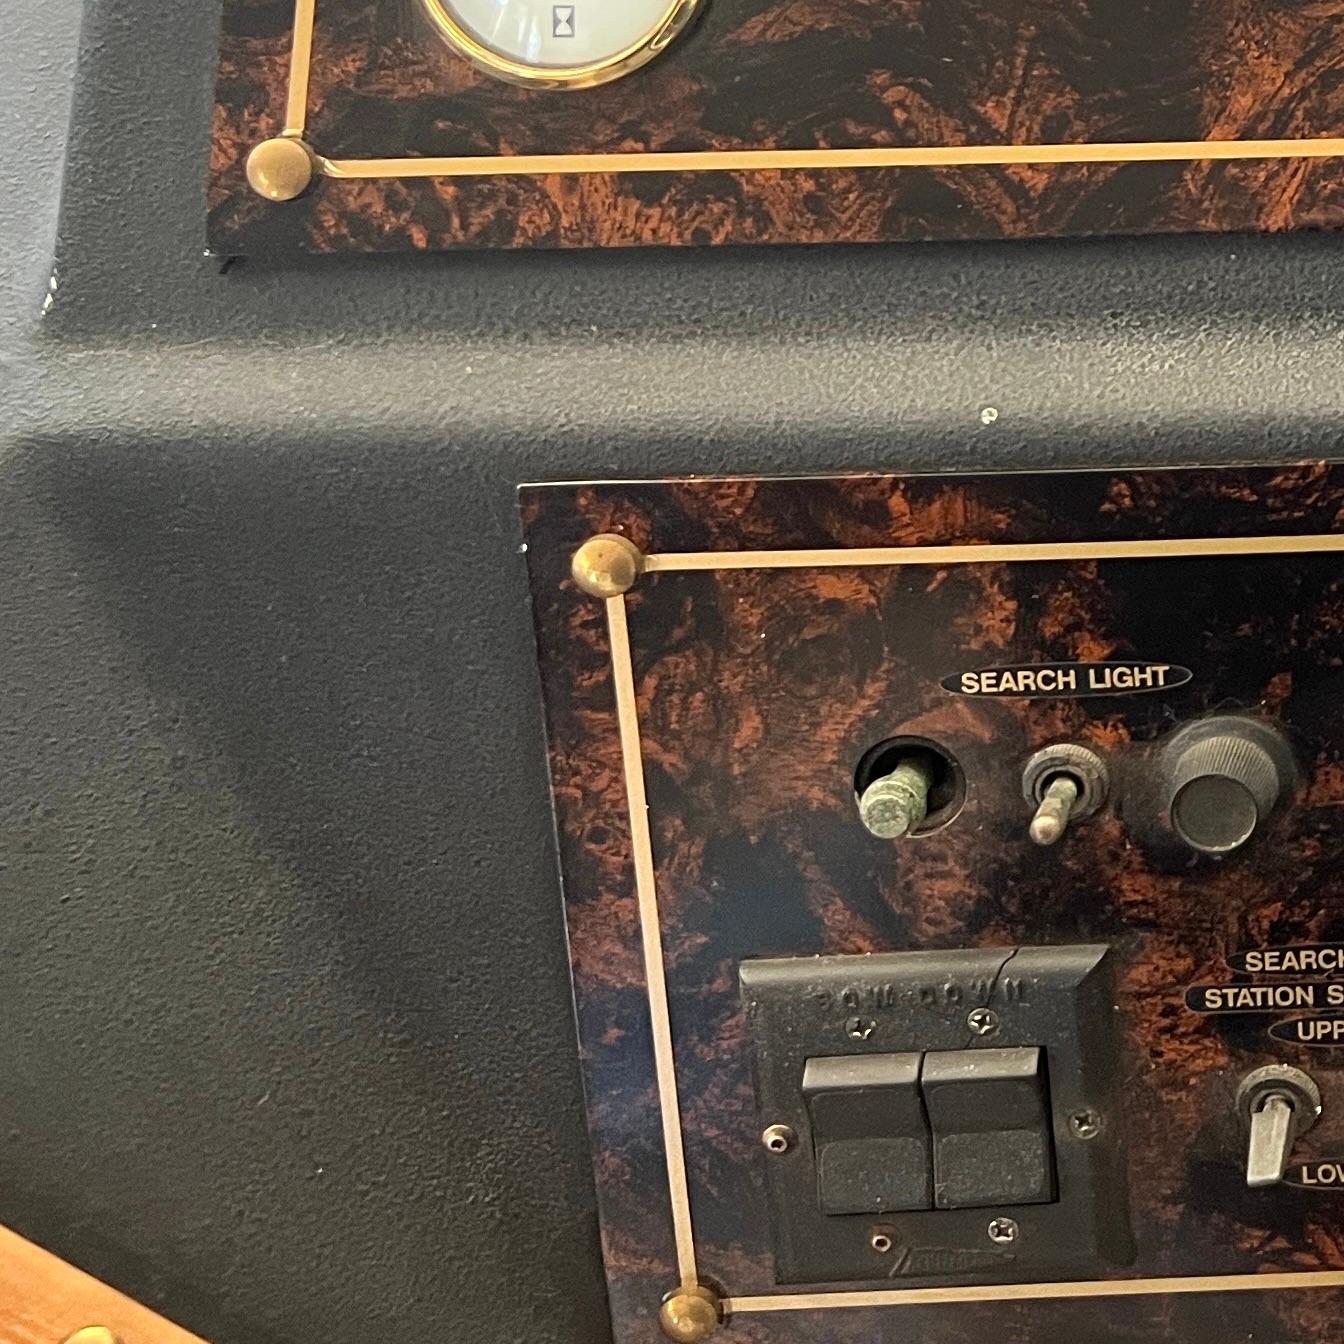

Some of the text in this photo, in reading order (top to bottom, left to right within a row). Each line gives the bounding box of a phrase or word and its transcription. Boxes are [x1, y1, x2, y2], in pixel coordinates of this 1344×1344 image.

[961, 665, 1170, 694] SEARCH LIGHT
[1205, 985, 1314, 1008] STATION
